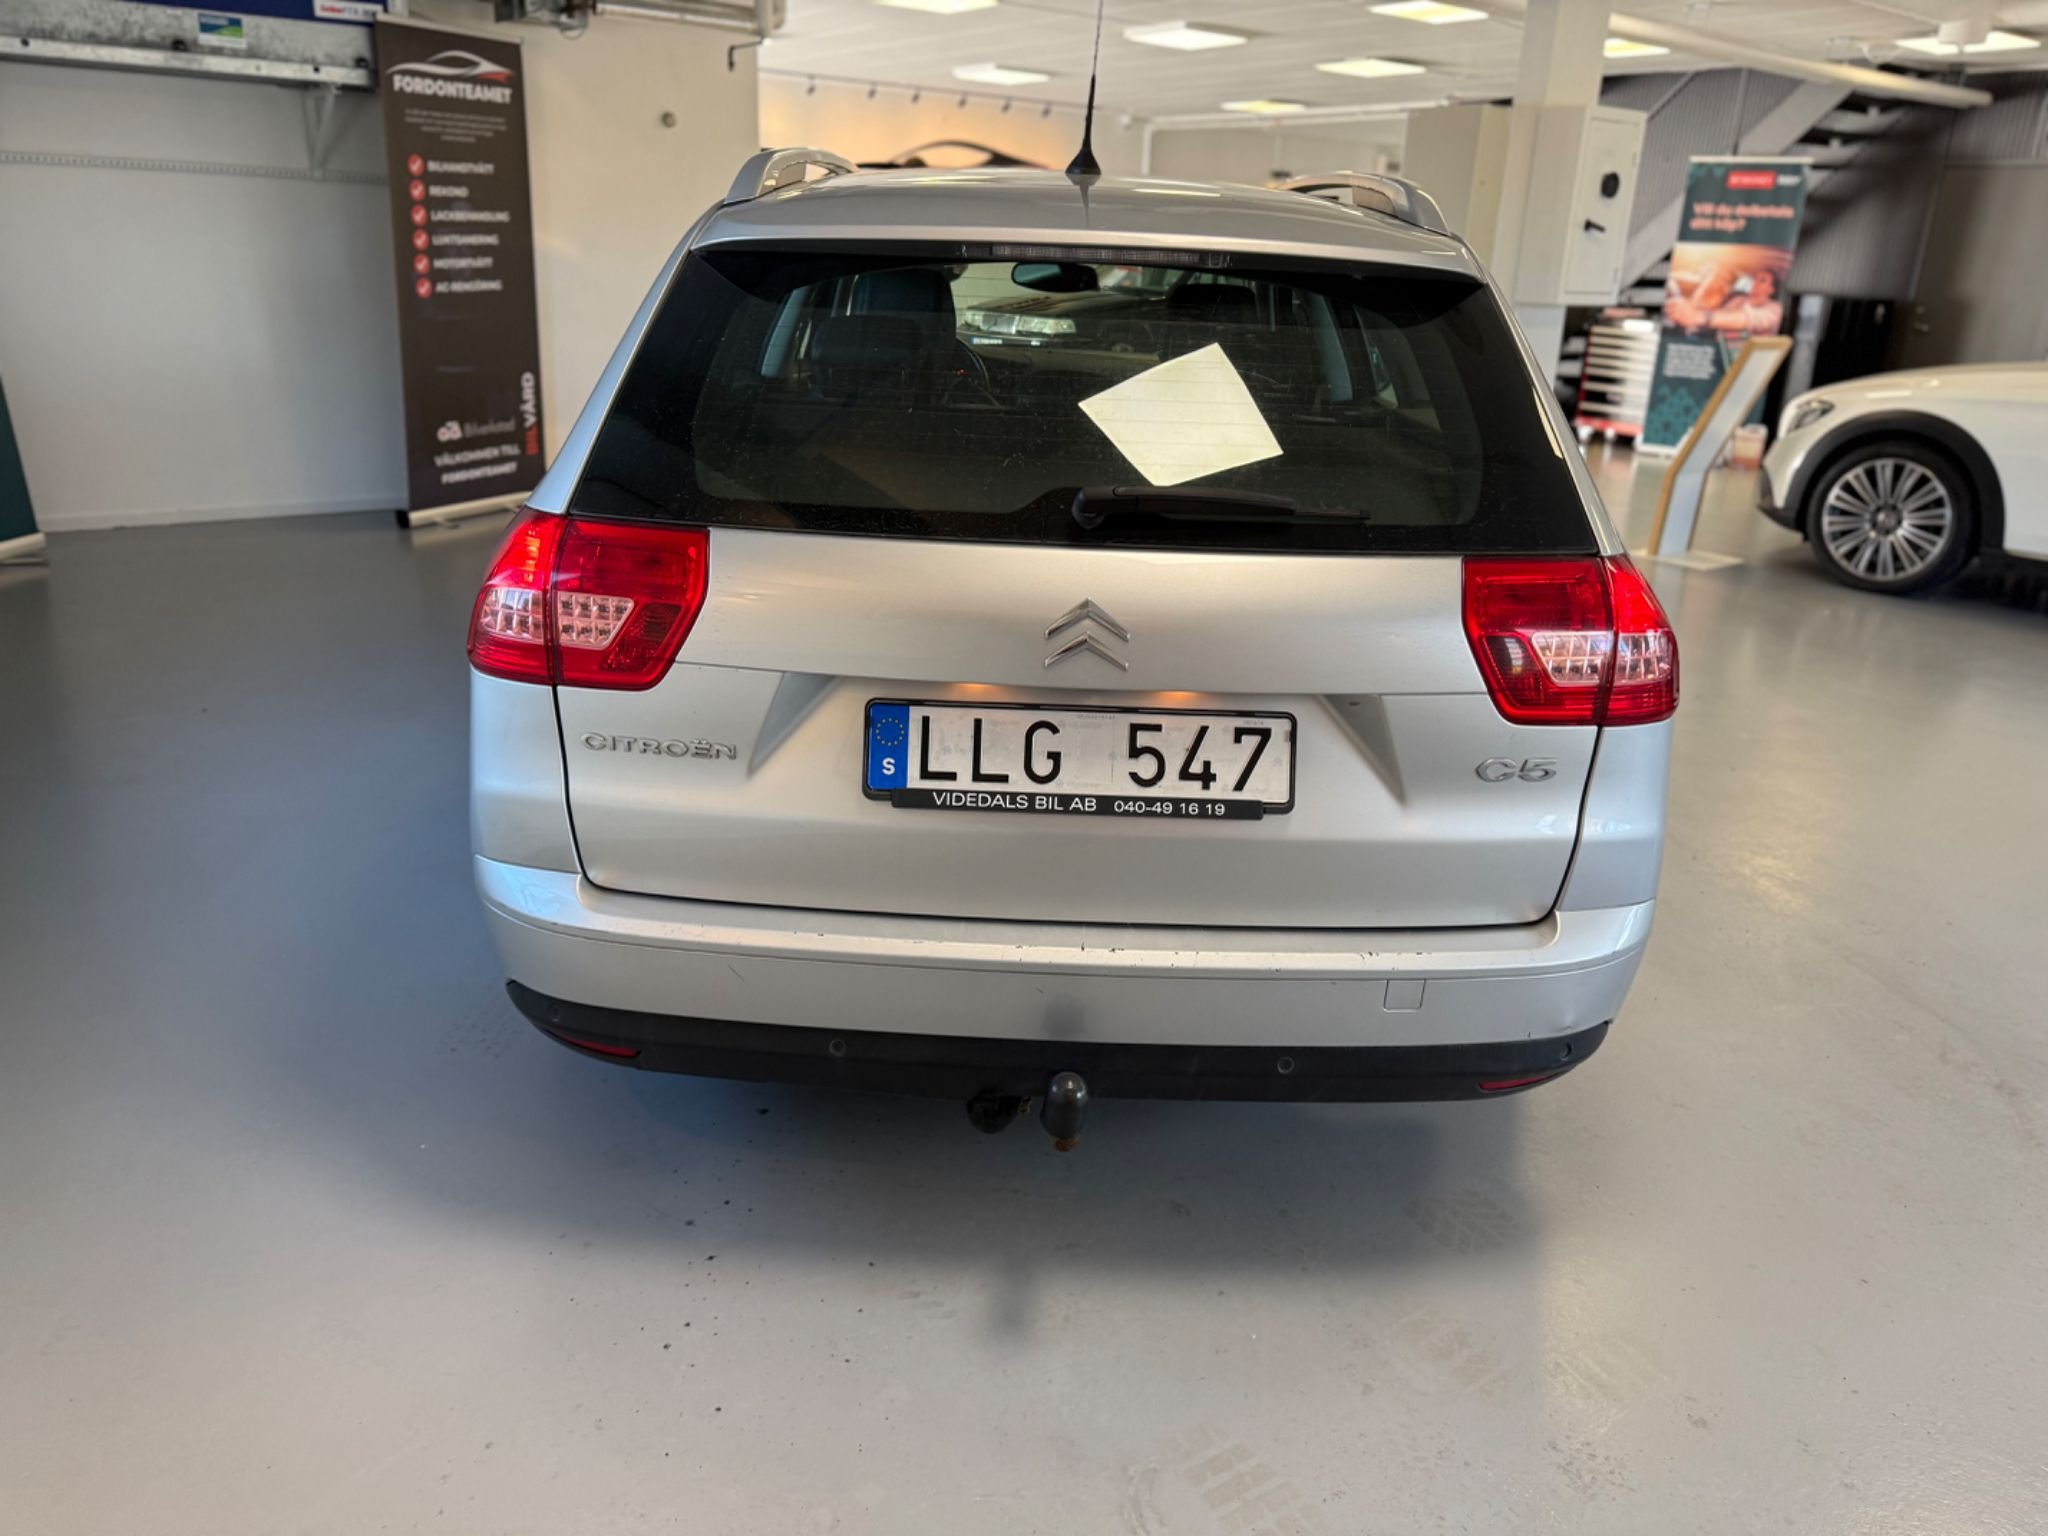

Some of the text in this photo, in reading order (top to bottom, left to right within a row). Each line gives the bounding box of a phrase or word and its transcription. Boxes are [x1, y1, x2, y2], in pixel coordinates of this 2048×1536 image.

[393, 74, 513, 104] FORDONTEAMET
[580, 732, 738, 760] CITROËN
[881, 715, 1273, 793] S LLG 547
[1474, 757, 1558, 783] C5
[932, 791, 1226, 816] VIDEDALS BIL AB 040-49 16 19
